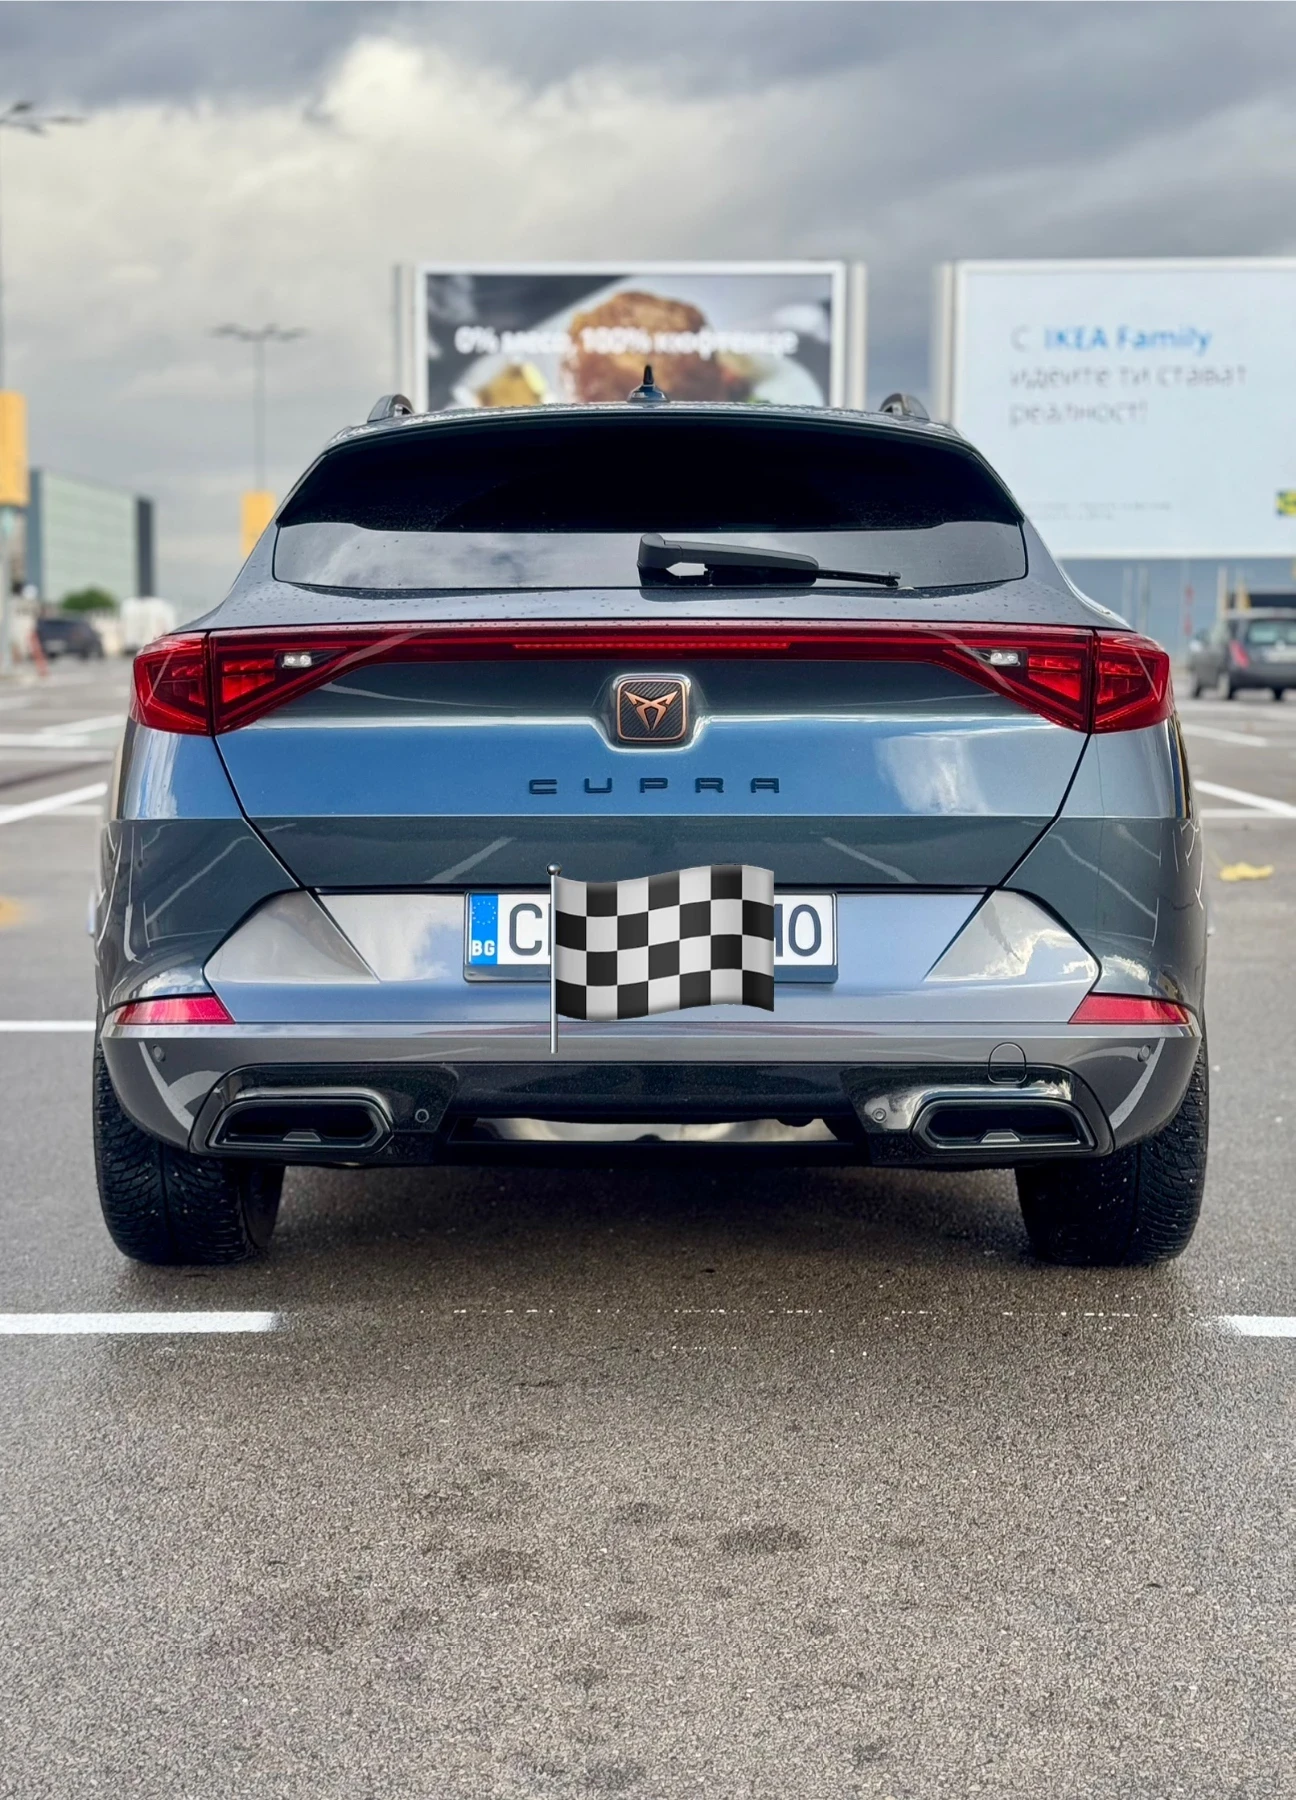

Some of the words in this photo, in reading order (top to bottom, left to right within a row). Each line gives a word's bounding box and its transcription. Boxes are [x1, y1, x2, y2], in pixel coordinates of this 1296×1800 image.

[455, 326, 499, 353] 0%
[582, 326, 651, 354] 100%
[1044, 325, 1108, 350] IKEA
[1116, 324, 1212, 357] Family
[1119, 366, 1151, 387] ти
[1156, 366, 1247, 387] стават
[529, 777, 780, 795] CUPRA
[509, 903, 550, 956] C
[472, 939, 496, 956] BG
